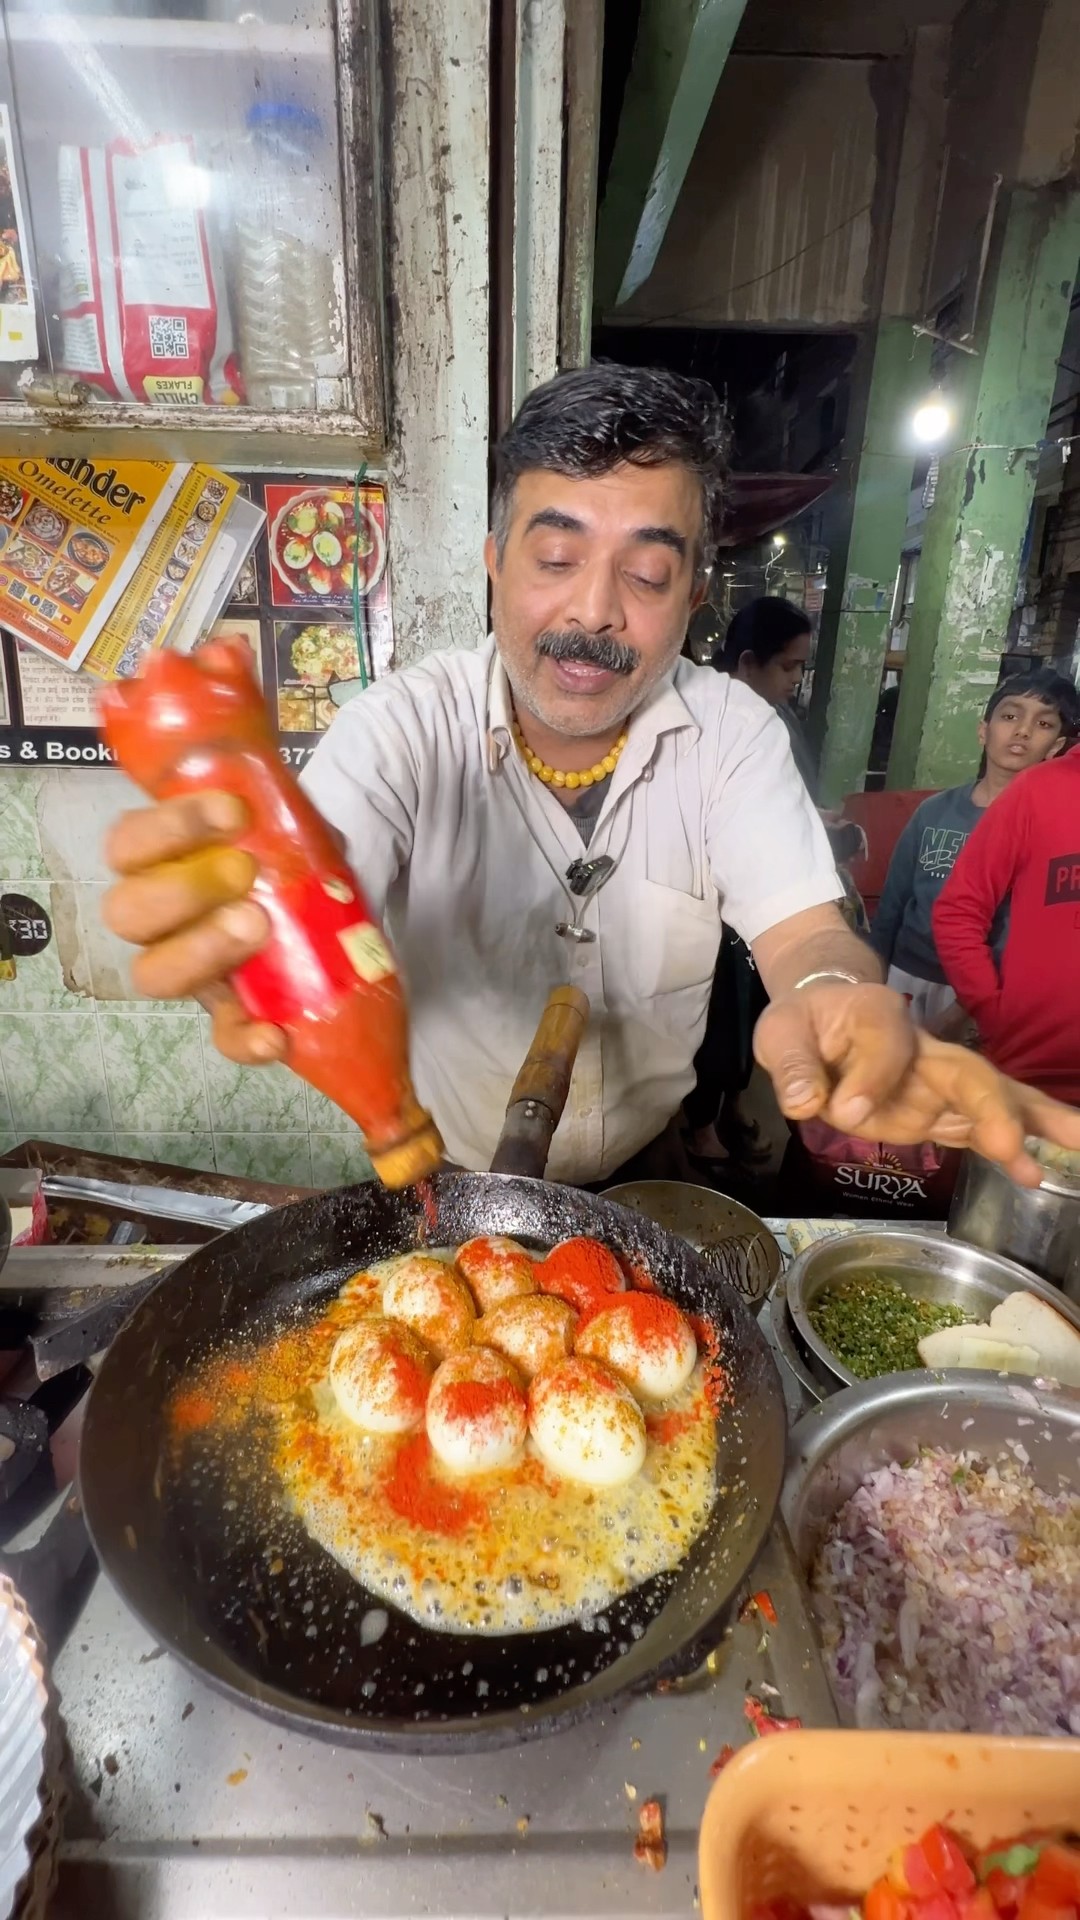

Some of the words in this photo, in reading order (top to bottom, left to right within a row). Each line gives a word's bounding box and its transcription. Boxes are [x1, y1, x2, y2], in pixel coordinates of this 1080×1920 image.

[156, 380, 192, 390] FLAKES
[154, 392, 199, 405] CHILLI
[18, 460, 112, 525] Omelette
[20, 741, 38, 759] &
[834, 1166, 927, 1199] SURYA
[842, 1191, 869, 1201] Women
[871, 1196, 893, 1205] Ethnic
